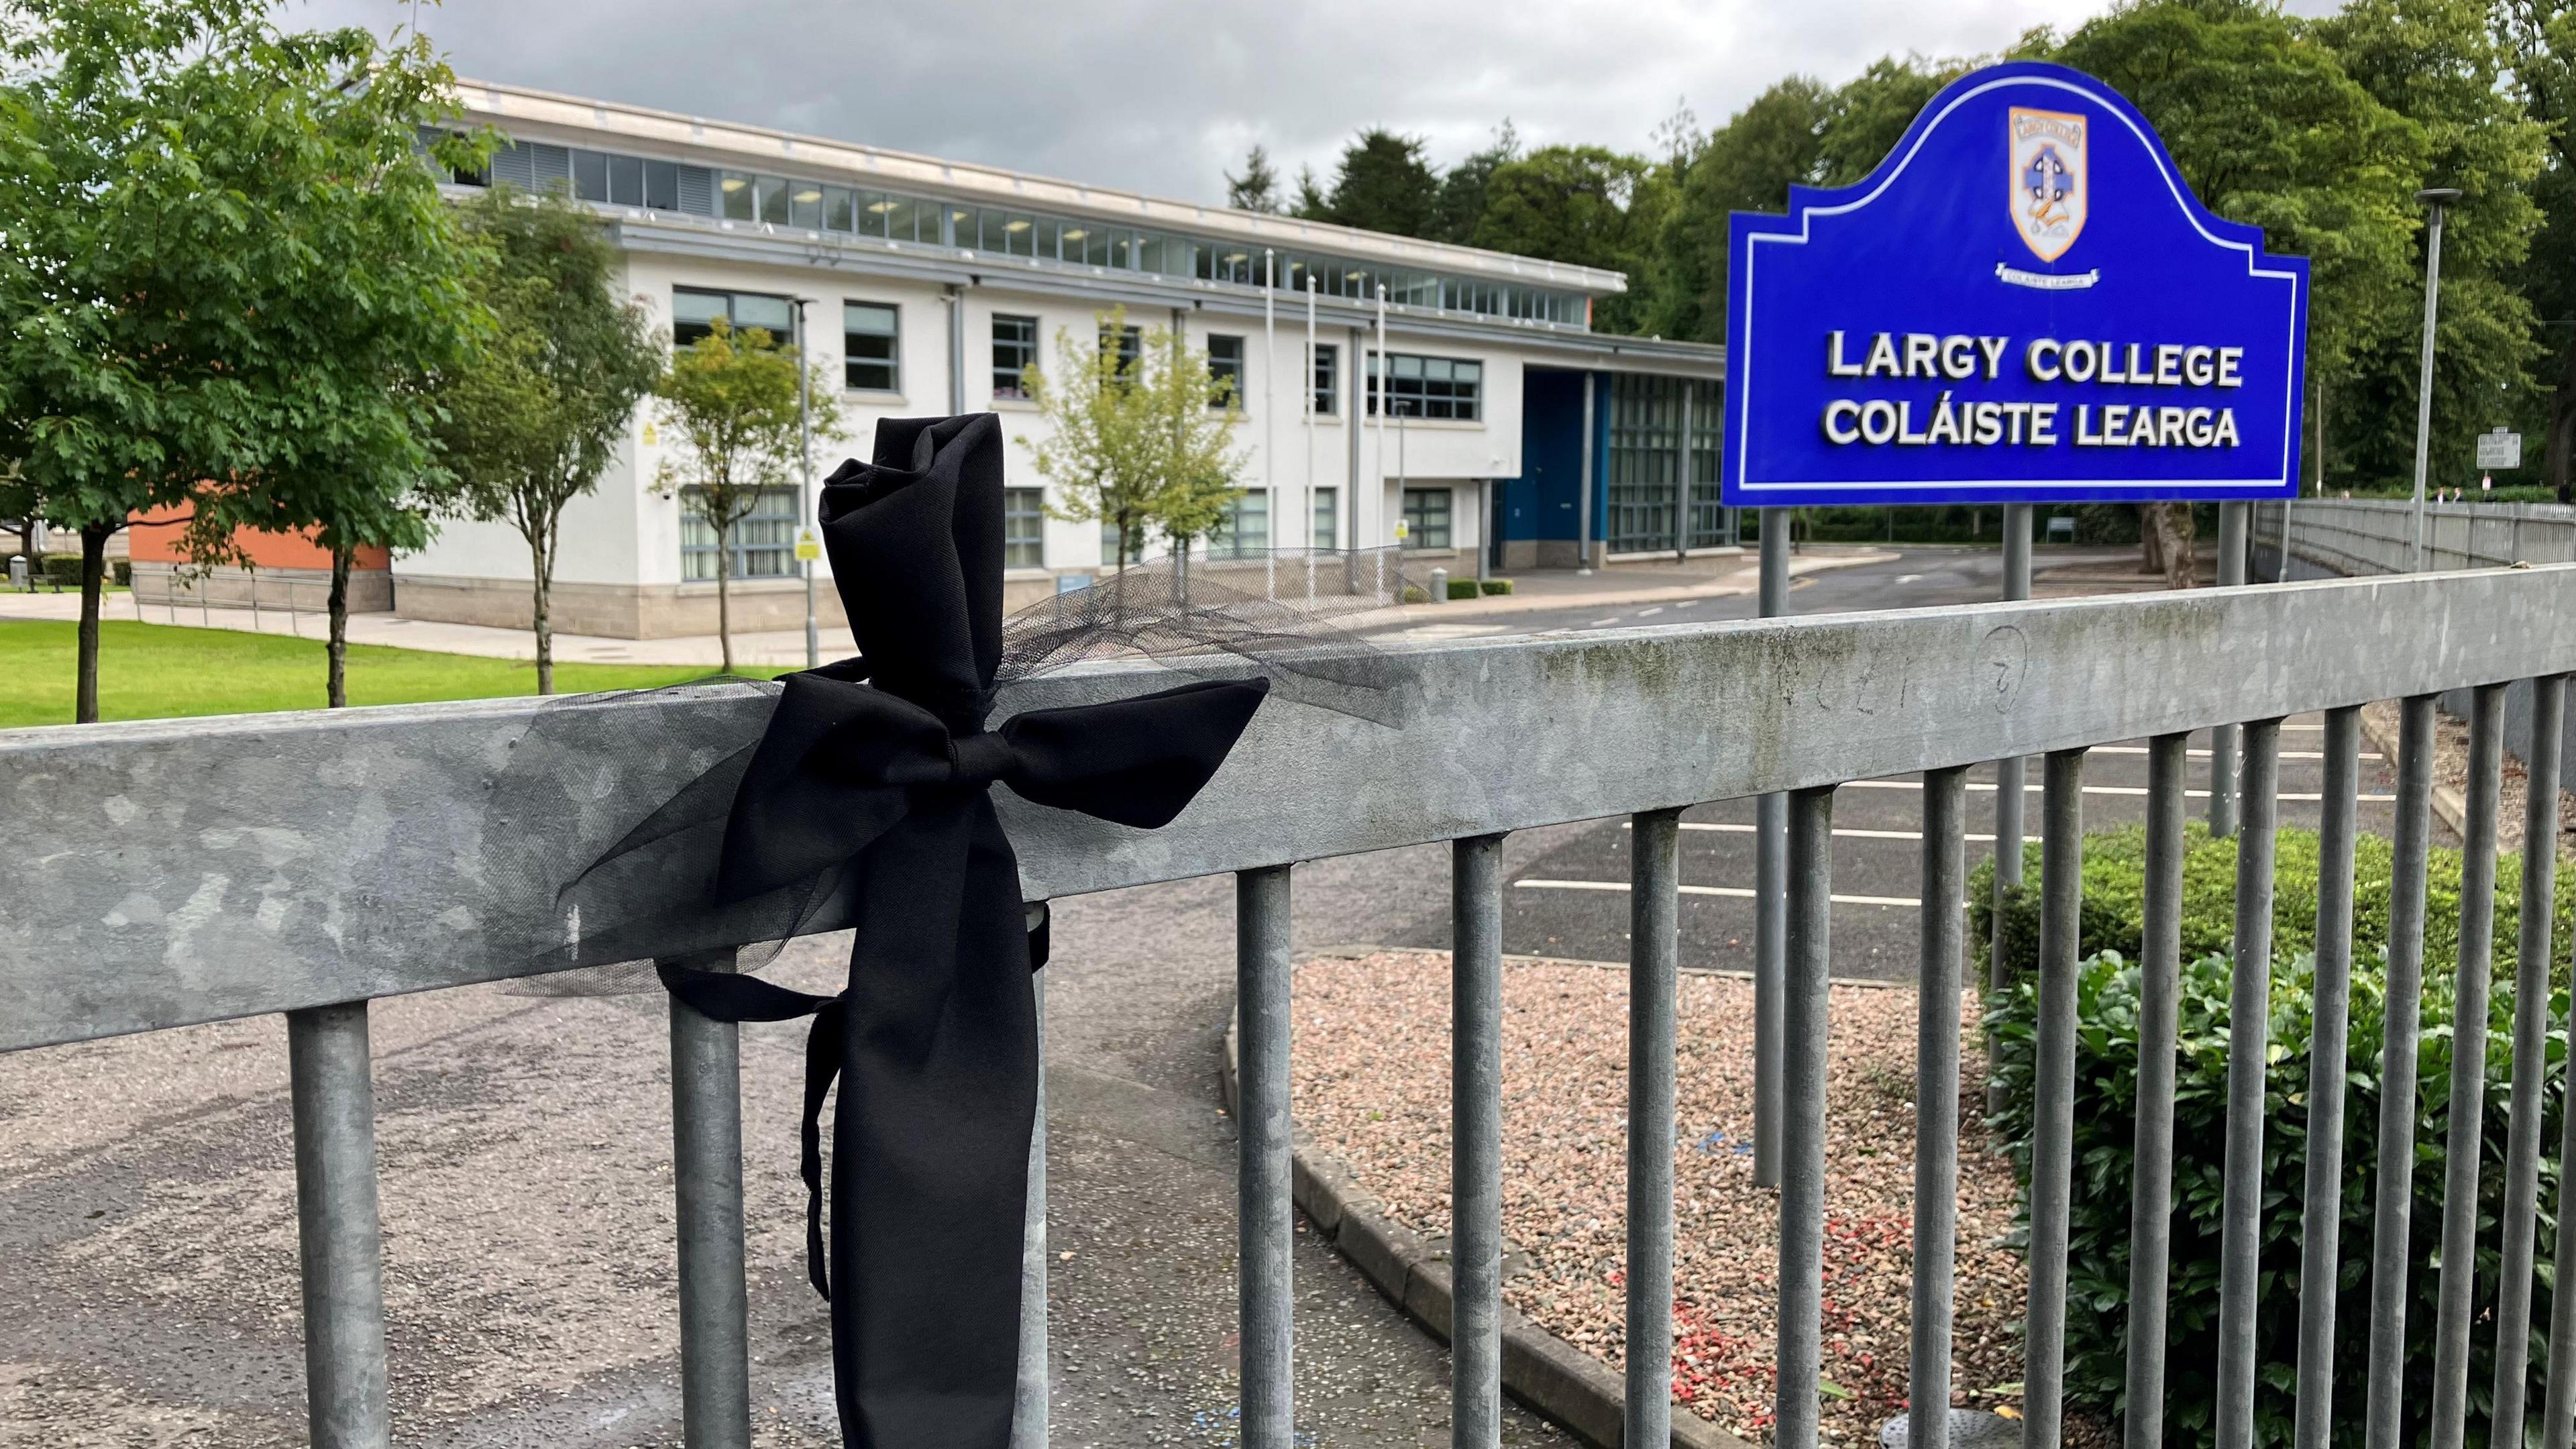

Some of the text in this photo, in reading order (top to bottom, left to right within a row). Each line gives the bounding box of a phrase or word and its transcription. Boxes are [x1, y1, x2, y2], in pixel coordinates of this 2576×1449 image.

[1830, 329, 2244, 388] LARGY COLLEGE
[1824, 389, 2241, 447] COLÁISTE LEARGA
